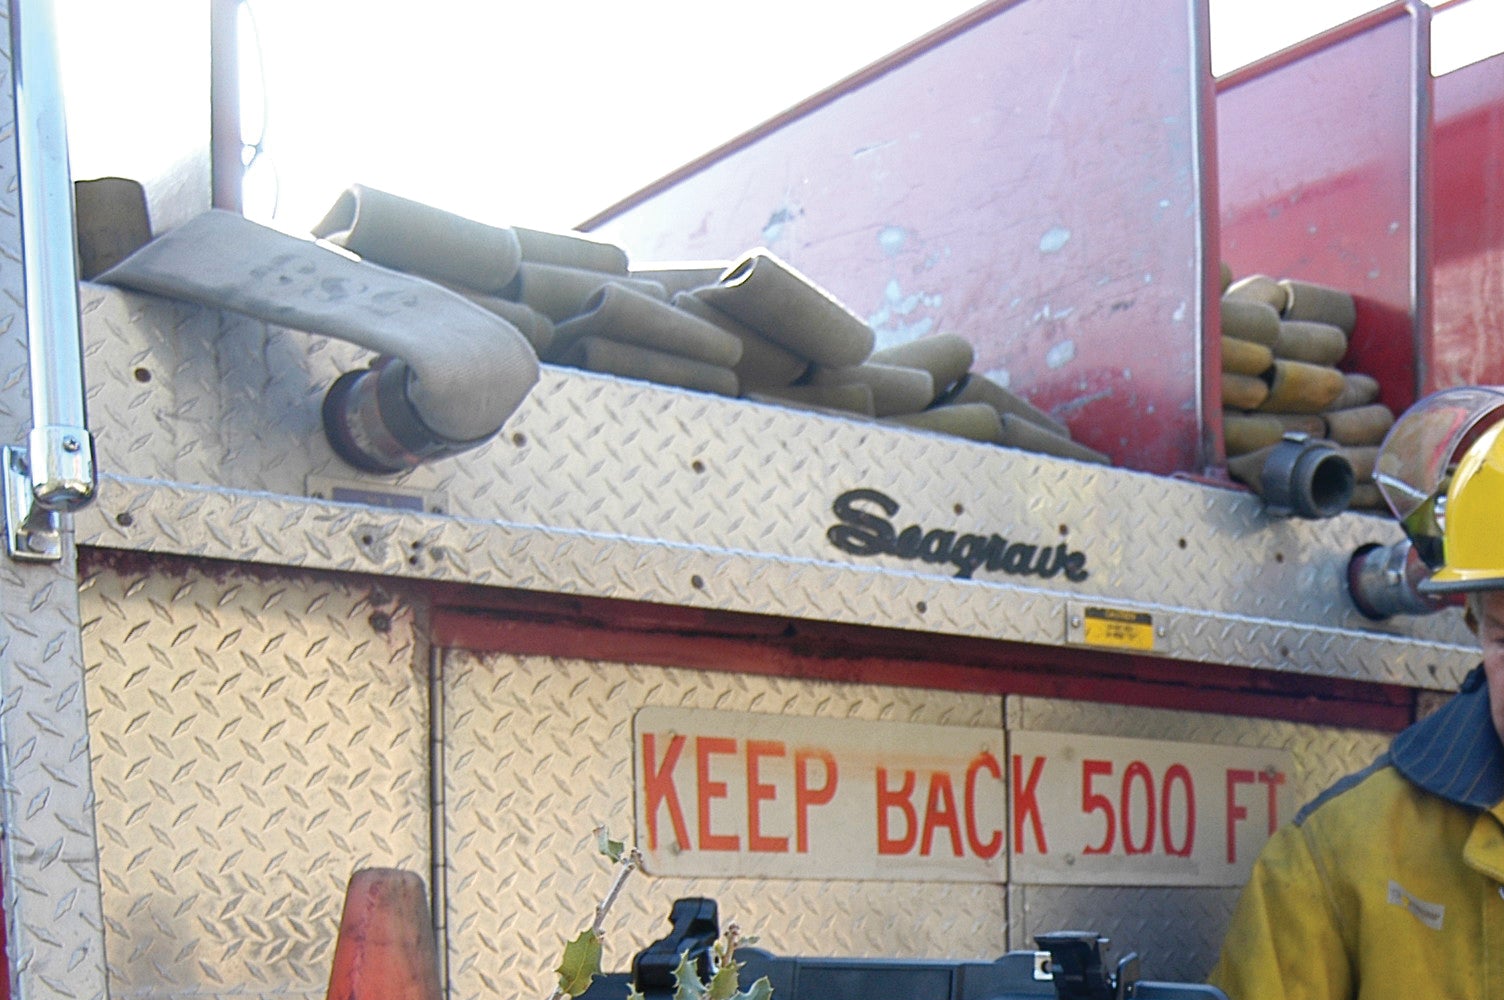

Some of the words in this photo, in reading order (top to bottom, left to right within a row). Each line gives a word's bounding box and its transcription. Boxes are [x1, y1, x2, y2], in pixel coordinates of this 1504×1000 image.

[827, 487, 1088, 582] Seagrave
[642, 733, 839, 853] KEEP
[876, 752, 1048, 860] BACK
[1082, 760, 1196, 858] 500
[1226, 769, 1286, 864] FT
